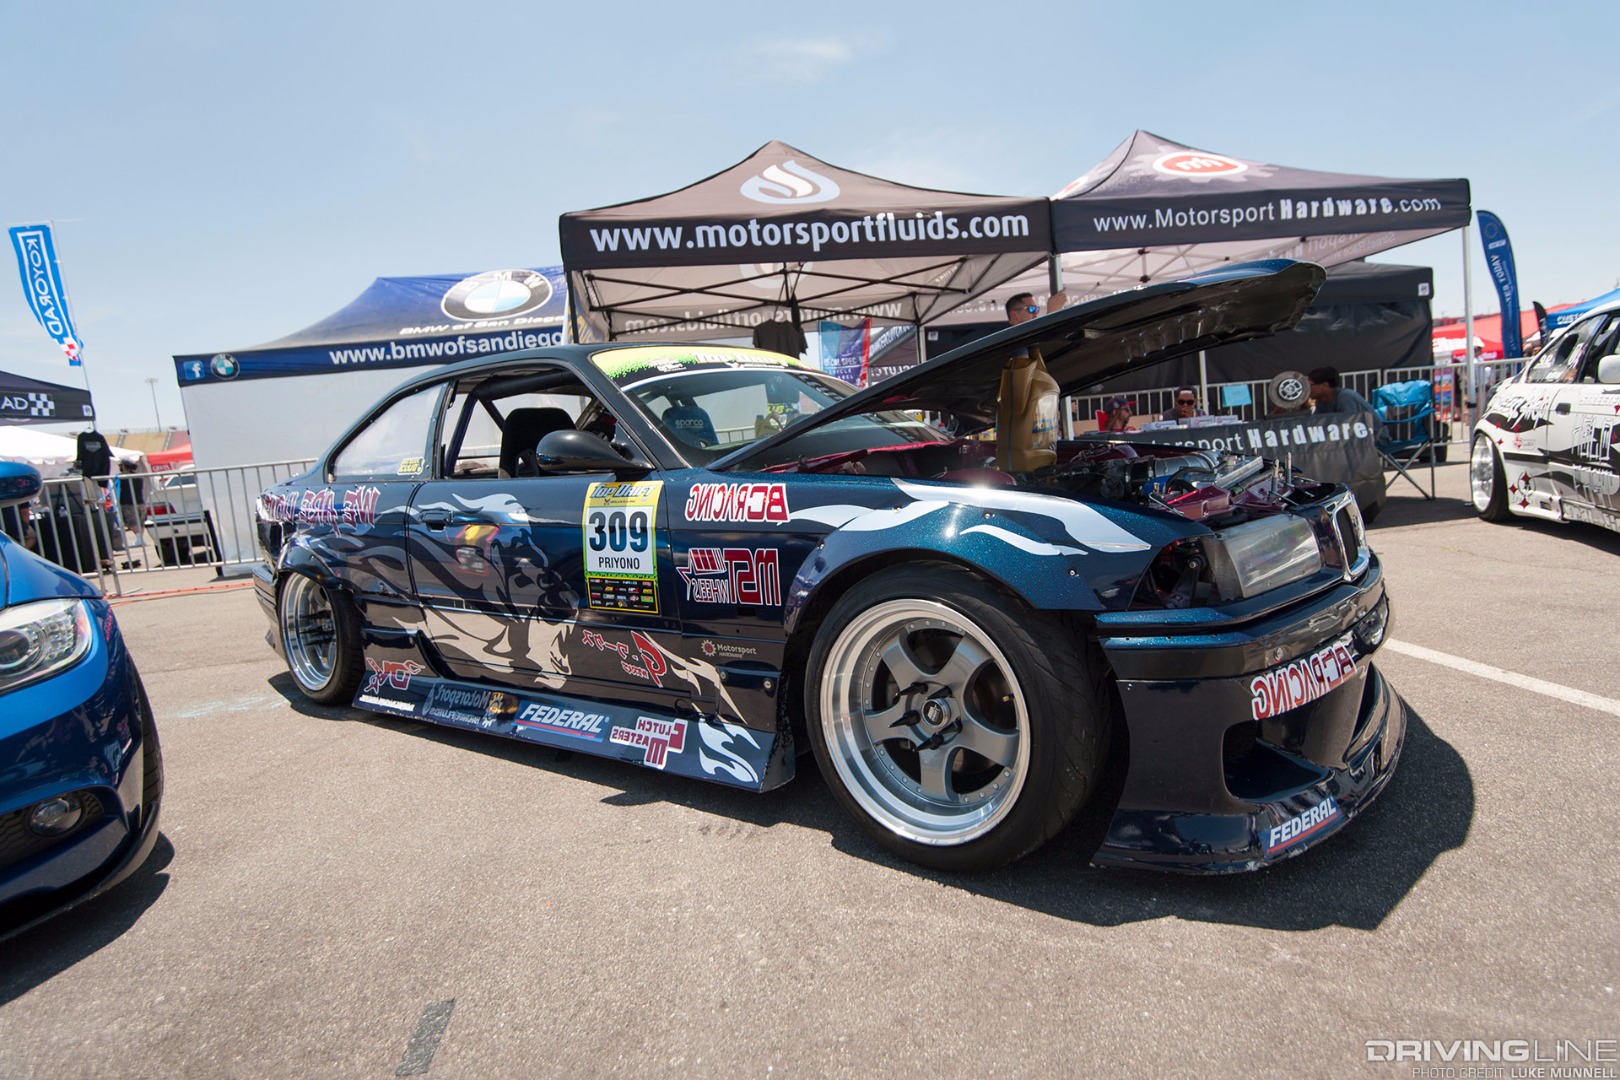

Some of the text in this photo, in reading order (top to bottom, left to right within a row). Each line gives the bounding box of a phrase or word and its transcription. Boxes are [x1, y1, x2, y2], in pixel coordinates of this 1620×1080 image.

[1093, 202, 1275, 232] www.Motorsport
[590, 212, 1029, 252] www.motorsportfluids.com
[452, 322, 473, 330] of
[474, 319, 510, 328] San
[329, 330, 564, 365] www.bmwofsandiego
[1246, 420, 1368, 448] Hardware
[590, 483, 655, 499] TOP DRIFT
[588, 511, 648, 552] 309
[598, 556, 640, 569] PRIYONO
[717, 644, 757, 655] Motorsport
[520, 704, 604, 732] FEDERAL
[1269, 797, 1337, 848] FEDERAL
